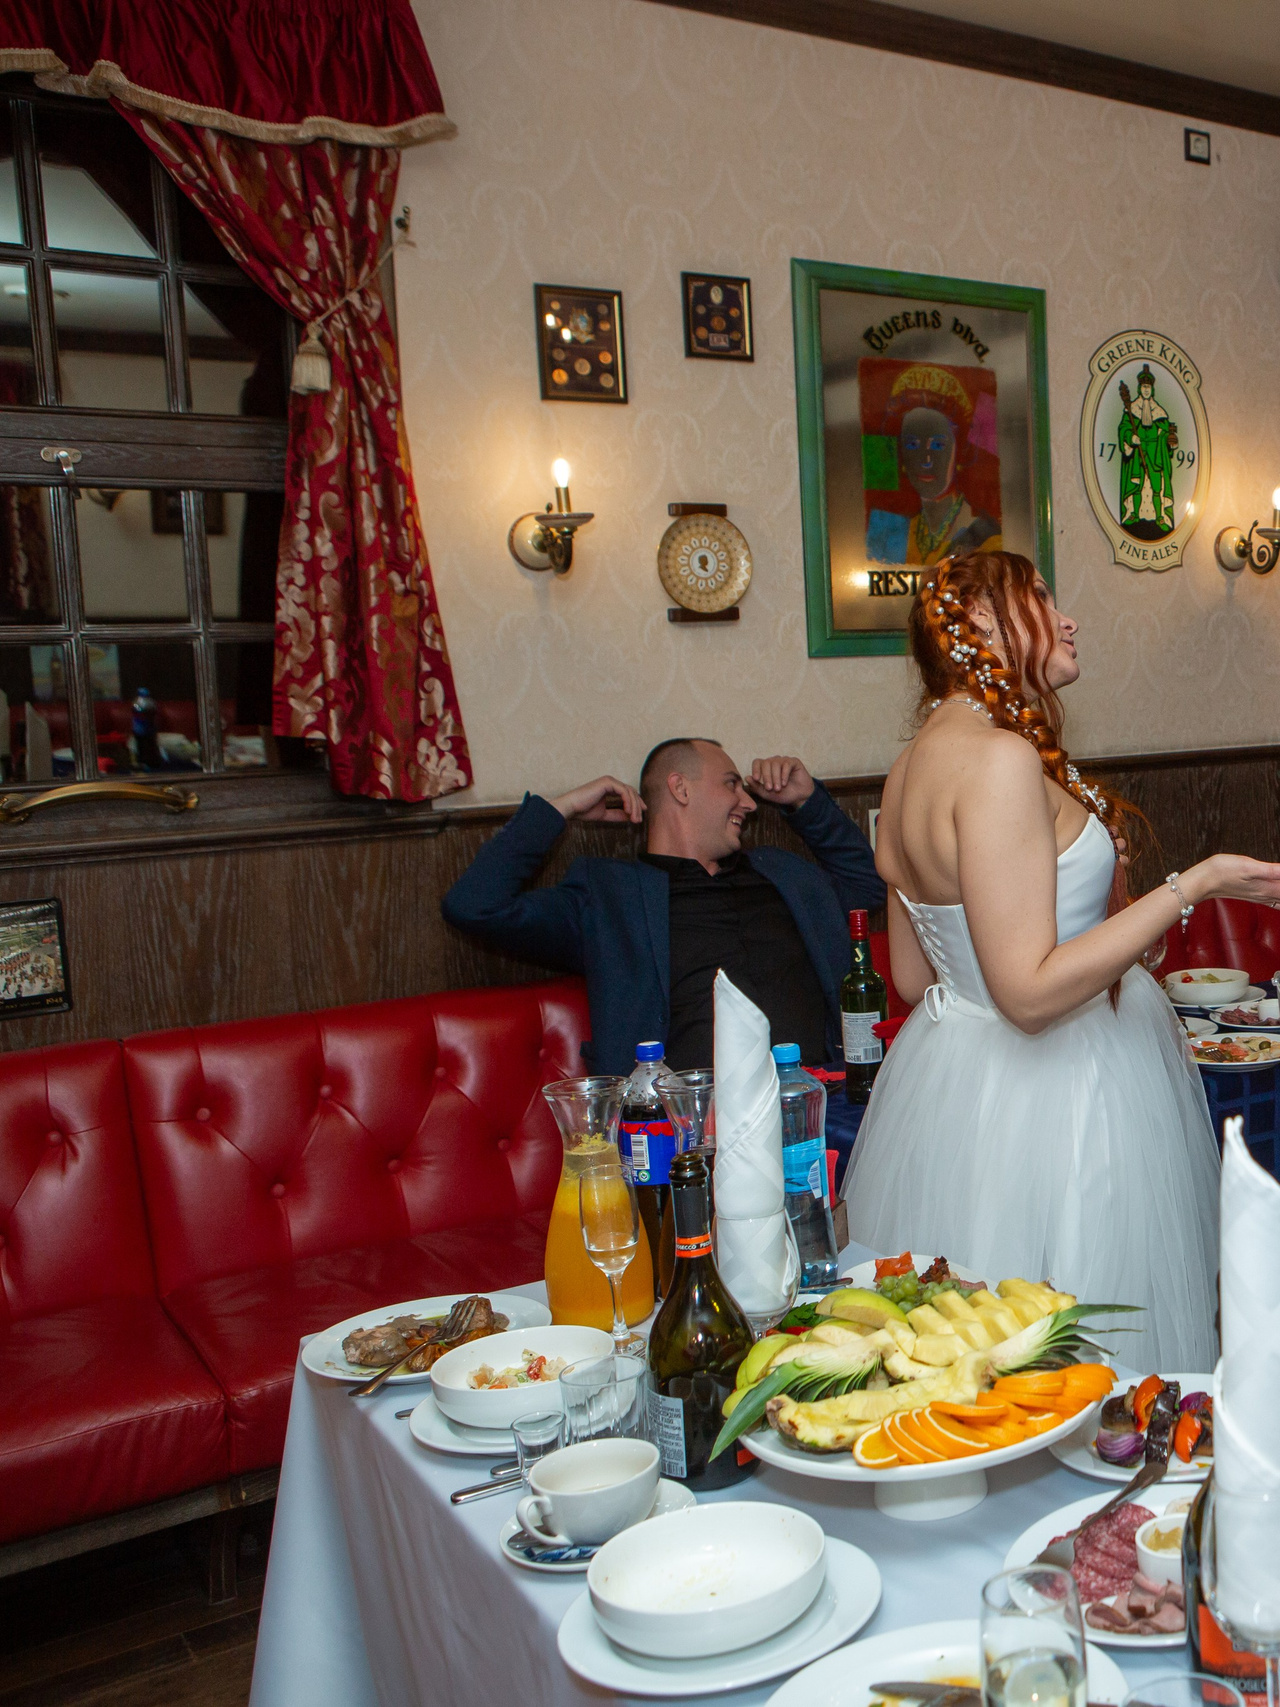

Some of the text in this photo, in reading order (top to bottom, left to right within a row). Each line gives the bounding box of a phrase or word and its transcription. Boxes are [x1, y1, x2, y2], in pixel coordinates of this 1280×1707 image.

[1097, 339, 1194, 384] GREENE KING
[1119, 540, 1178, 561] FINE ALES
[867, 570, 920, 597] REST
